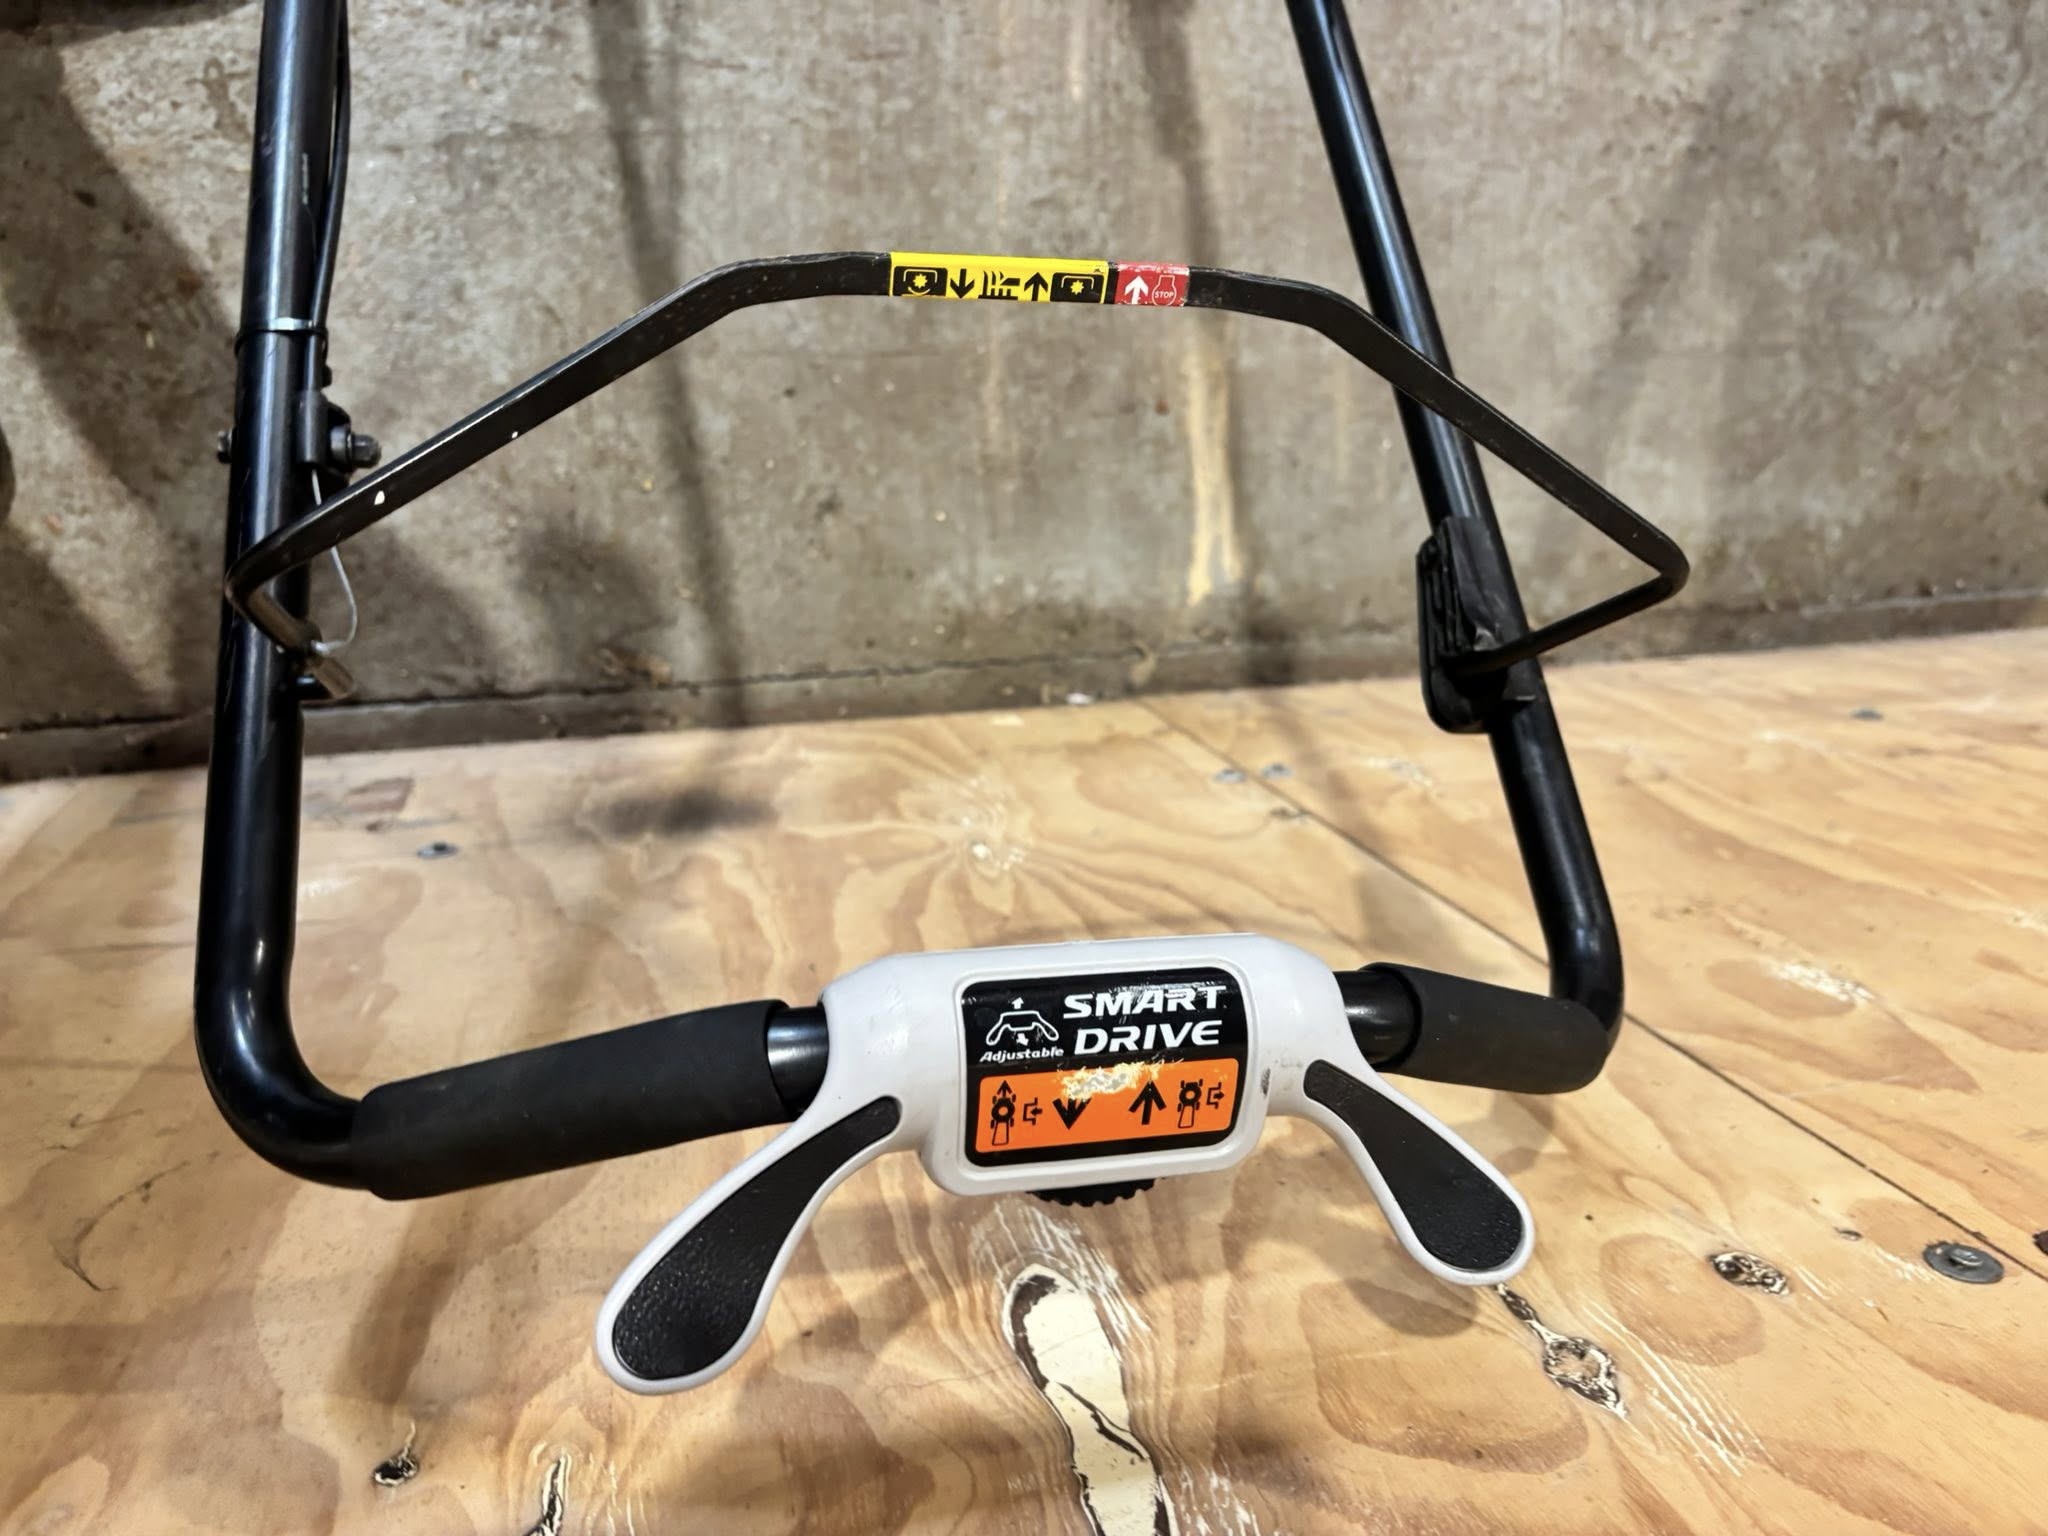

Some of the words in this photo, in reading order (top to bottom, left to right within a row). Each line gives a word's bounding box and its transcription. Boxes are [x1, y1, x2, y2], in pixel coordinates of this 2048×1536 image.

[1154, 289, 1174, 299] STOP
[1063, 985, 1226, 1019] SMART
[1074, 1019, 1223, 1055] DRIVE
[979, 1046, 1065, 1064] Adjustable
